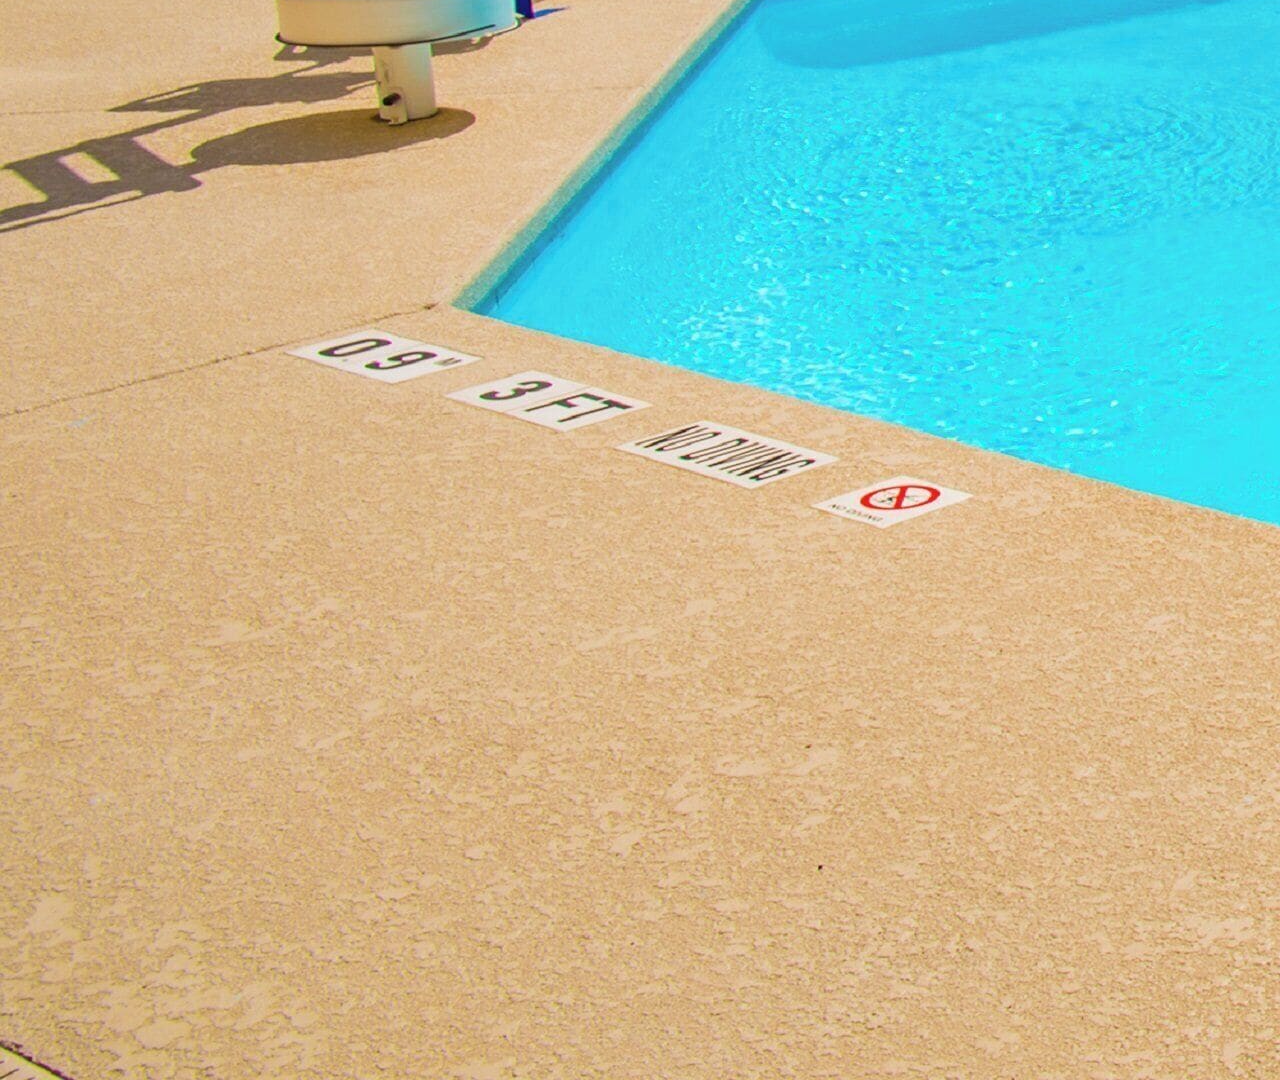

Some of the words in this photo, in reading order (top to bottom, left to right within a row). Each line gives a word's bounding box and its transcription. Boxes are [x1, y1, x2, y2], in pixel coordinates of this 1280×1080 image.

[479, 380, 553, 401] 3
[524, 392, 635, 423] FT
[634, 425, 722, 452] NO
[679, 437, 816, 482] DIVING
